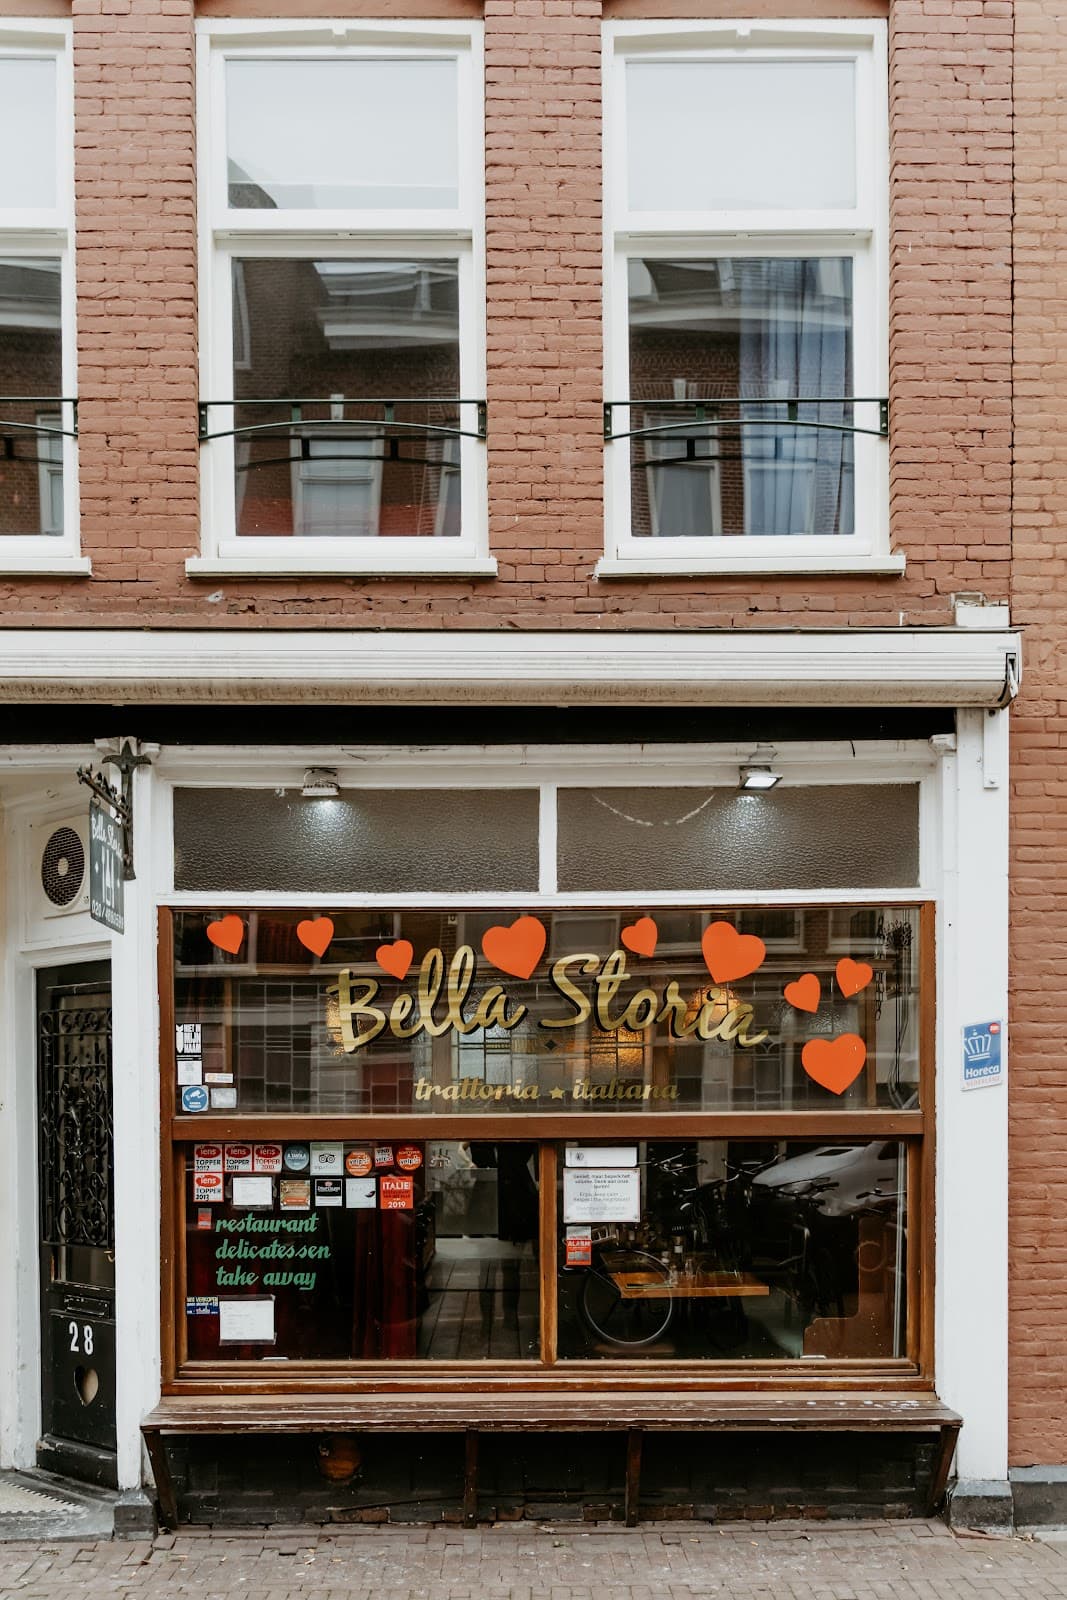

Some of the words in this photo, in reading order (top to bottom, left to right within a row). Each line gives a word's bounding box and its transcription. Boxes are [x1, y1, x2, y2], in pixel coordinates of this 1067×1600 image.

[91, 813, 107, 843] Bella
[326, 945, 528, 1053] Bella
[538, 949, 769, 1049] Storia
[966, 1065, 1000, 1078] Horeca
[413, 1076, 539, 1101] trattoria
[572, 1077, 680, 1101] italiana
[388, 1201, 406, 1209] 2019
[215, 1212, 319, 1233] restaurant
[215, 1239, 332, 1259] delicatessen
[216, 1265, 259, 1286] take
[263, 1272, 317, 1290] away
[69, 1321, 94, 1355] 28
